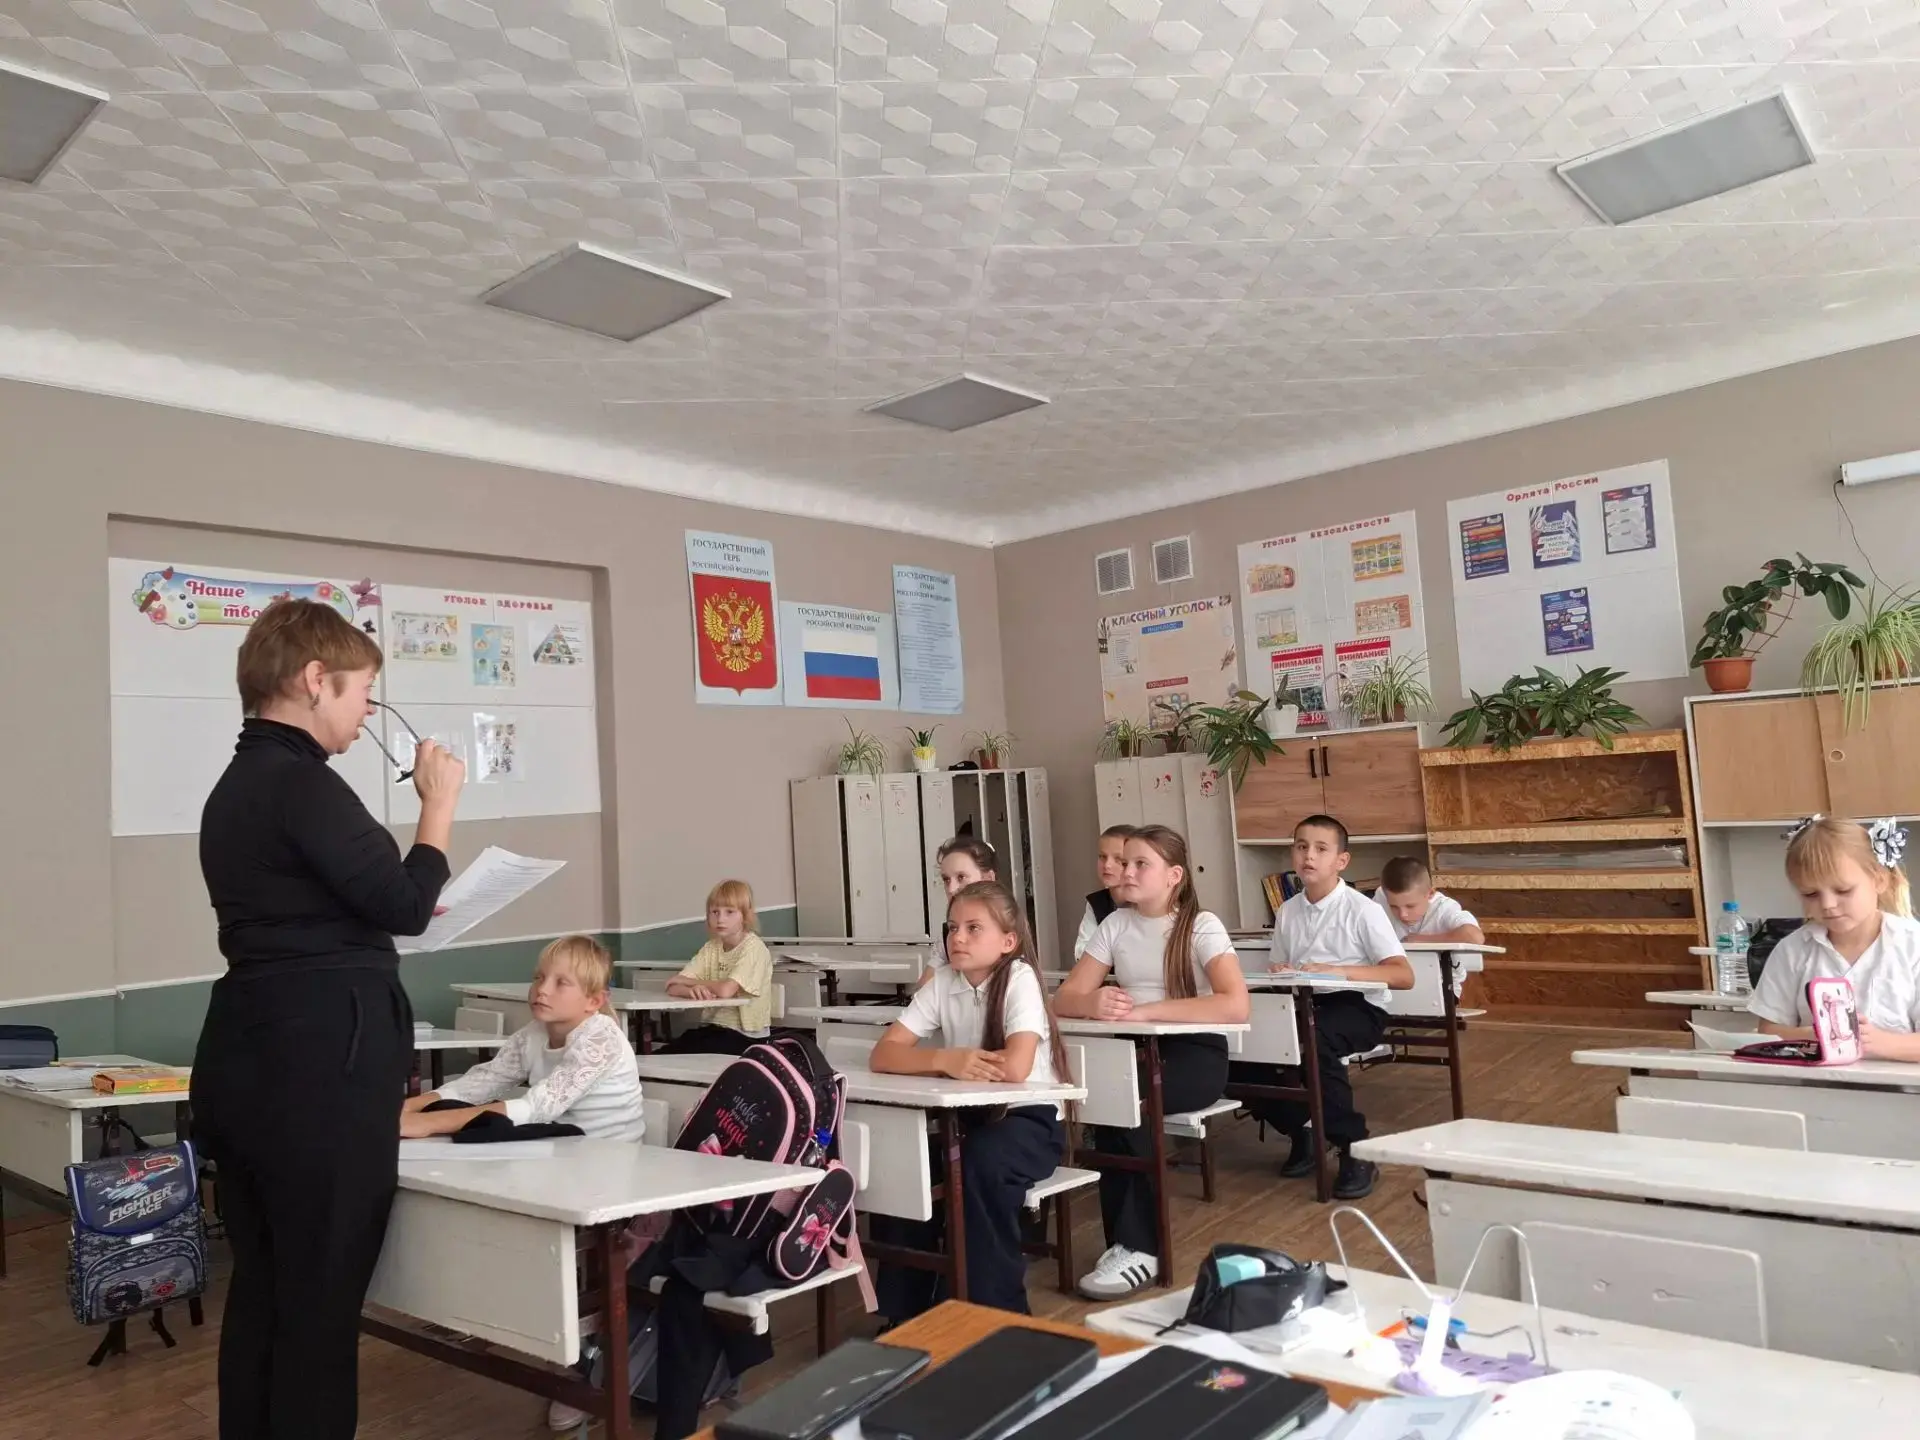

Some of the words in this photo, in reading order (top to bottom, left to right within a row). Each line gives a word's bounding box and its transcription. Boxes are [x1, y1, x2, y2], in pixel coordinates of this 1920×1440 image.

[1506, 487, 1550, 502] Орлята
[1554, 477, 1598, 491] России
[1262, 536, 1297, 548] УГОЛОК
[1310, 516, 1391, 538] БЕЗОПАСНОСТИ
[692, 538, 766, 556] ГОСУДАРСТВЕННЫЙ
[723, 553, 741, 562] ГЕРБ
[186, 580, 245, 598] Наше
[223, 604, 264, 618] тво
[797, 607, 865, 621] ГОСУДАРСТВЕННЫЙ
[1111, 608, 1166, 627] КЛАССНЫЙ
[1169, 600, 1214, 617] УГОЛОК
[1274, 657, 1321, 669] ВНИМАНИЕ!
[1338, 649, 1388, 662] ВНИМАНИЕ!
[115, 1170, 145, 1187] SUPER
[109, 1185, 173, 1222] FIGHTER
[137, 1201, 162, 1219] ACE
